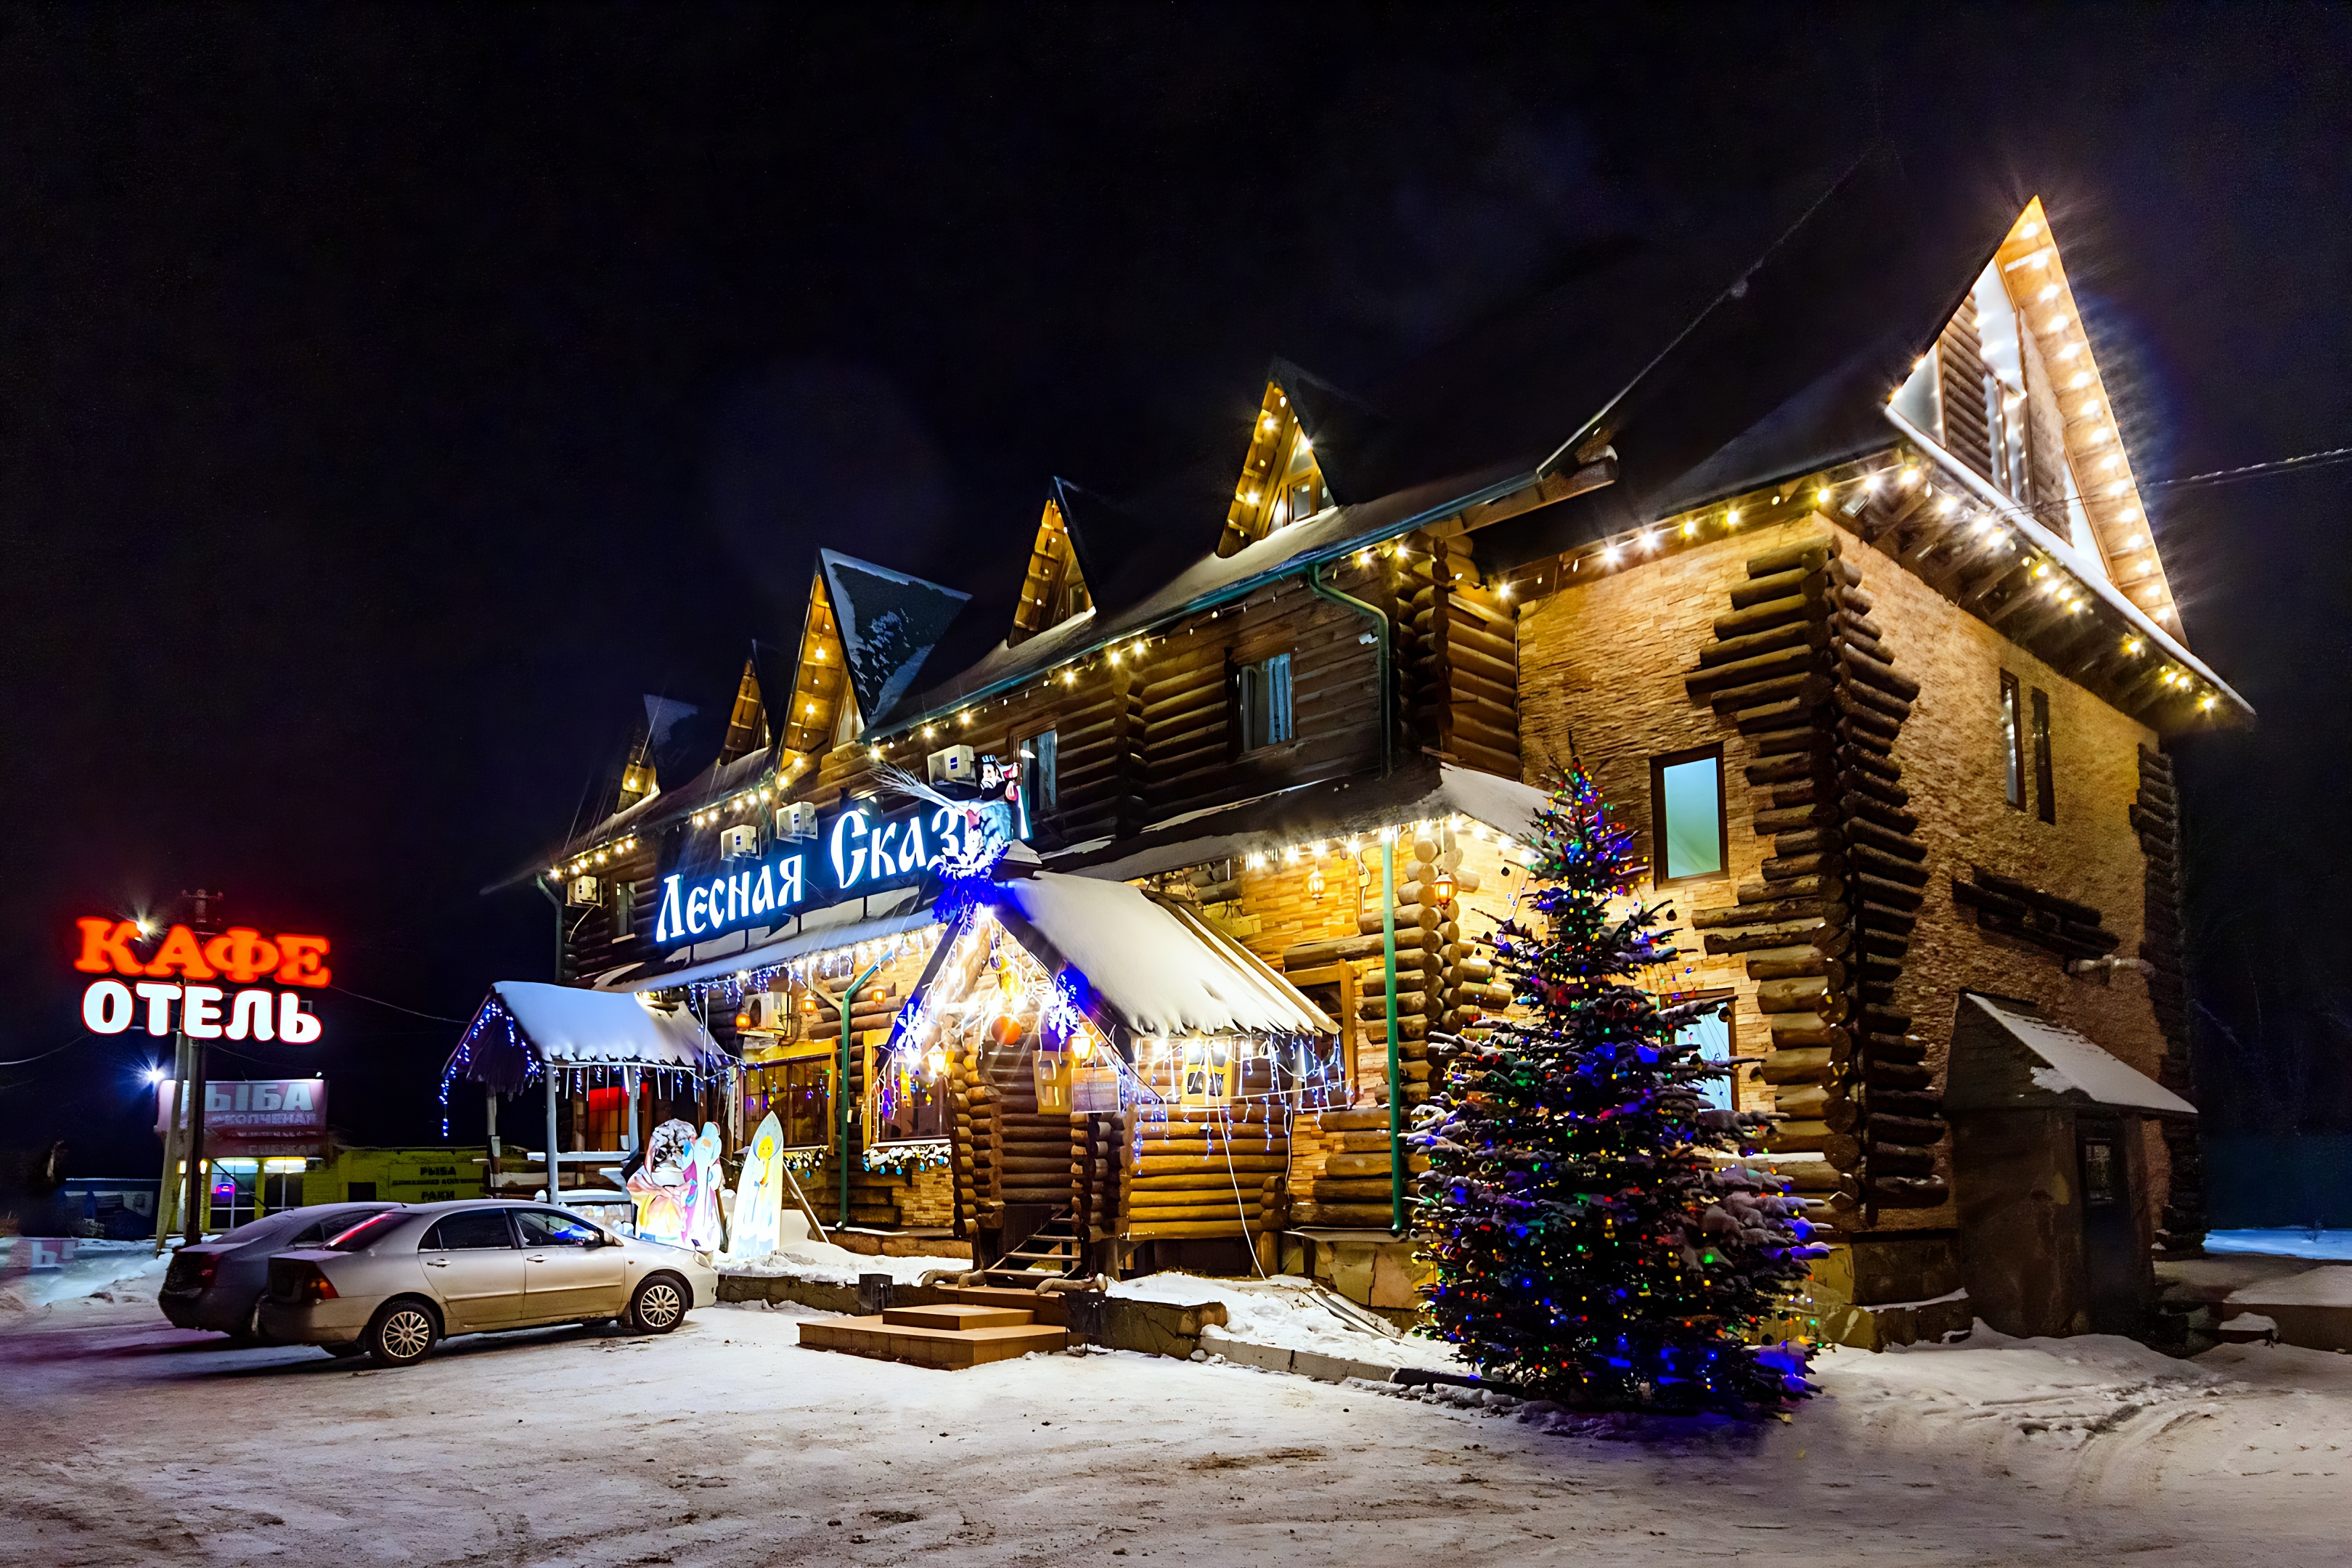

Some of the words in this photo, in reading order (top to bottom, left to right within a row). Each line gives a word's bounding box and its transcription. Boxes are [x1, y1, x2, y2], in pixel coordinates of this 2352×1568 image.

[656, 854, 802, 942] Лесная
[831, 785, 1030, 889] Сказ
[74, 916, 331, 988] КАФЕ
[81, 979, 323, 1045] ОТЕЛЬ
[181, 1083, 314, 1111] ЫБА
